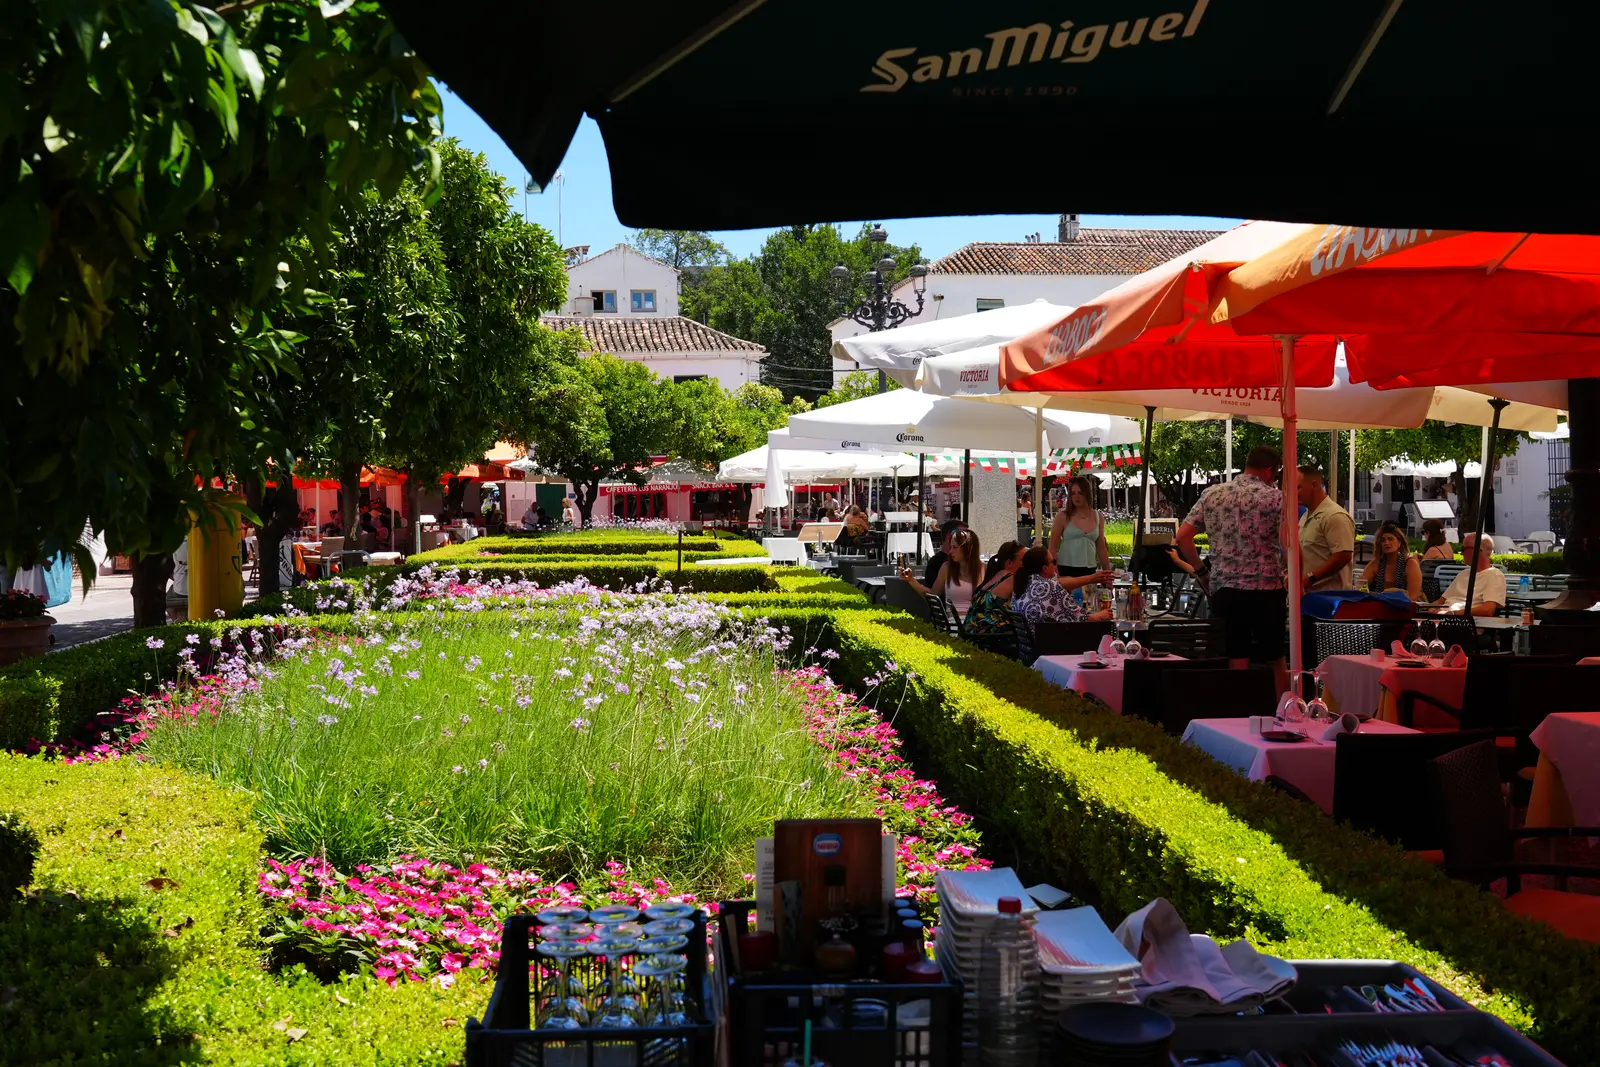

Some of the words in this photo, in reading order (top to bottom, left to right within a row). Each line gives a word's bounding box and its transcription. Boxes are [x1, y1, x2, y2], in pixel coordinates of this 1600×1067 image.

[951, 86, 1014, 97] SINCE
[1023, 85, 1079, 96] 1890
[1310, 223, 1433, 276] CIAB
[959, 369, 989, 382] VICTORIA
[895, 432, 925, 443] Corona
[841, 440, 861, 448] Corona
[650, 483, 680, 491] NARANJO
